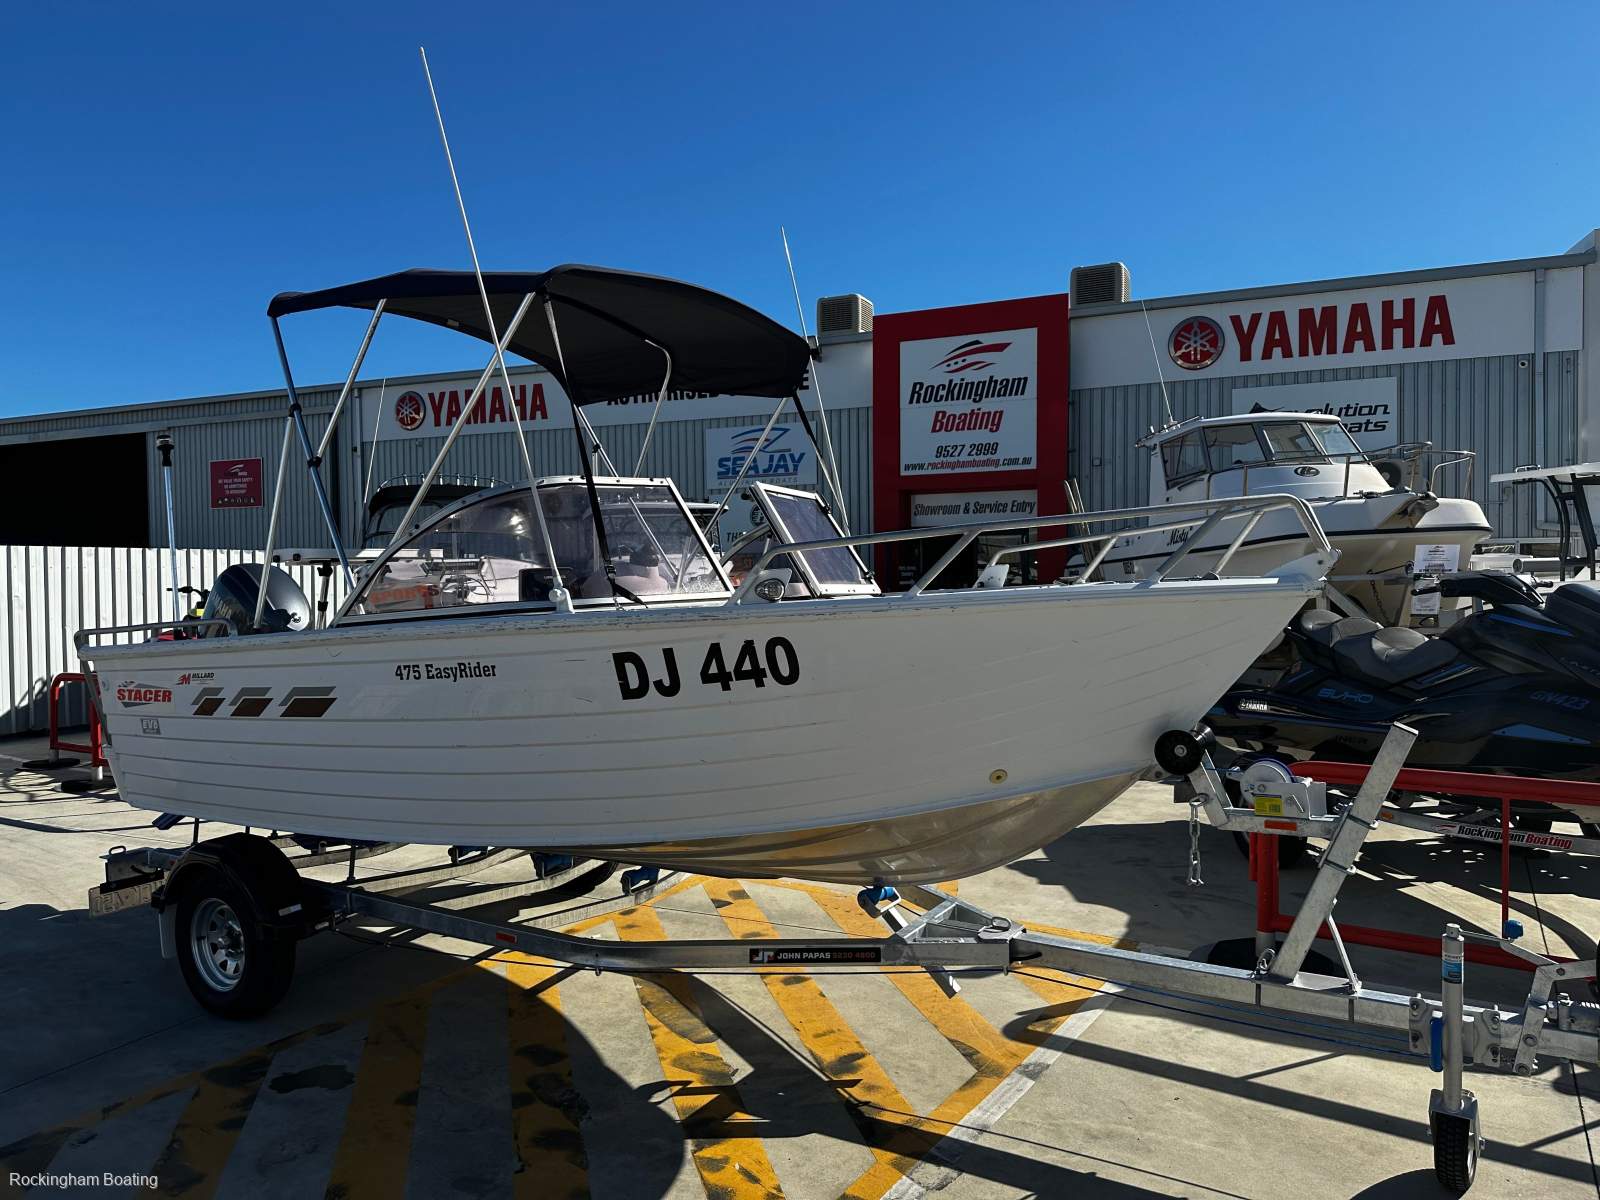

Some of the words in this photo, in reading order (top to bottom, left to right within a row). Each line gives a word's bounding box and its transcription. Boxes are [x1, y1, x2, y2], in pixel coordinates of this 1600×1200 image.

[1229, 294, 1456, 362] YAMAHA
[908, 375, 1028, 405] Rockingham
[427, 383, 548, 427] YAMAHA
[931, 407, 1004, 433] Boating
[935, 444, 966, 459] 9527
[967, 441, 999, 457] 2999
[904, 456, 1033, 471] www.rockinghamboating.com.au
[913, 503, 961, 517] Showroom
[962, 501, 971, 515] &
[972, 500, 1008, 514] Service
[1010, 499, 1036, 514] Entry
[395, 664, 422, 680] 475
[425, 661, 496, 682] EasyRider
[612, 647, 681, 700] DJ
[700, 636, 800, 691] 440
[117, 688, 172, 702] STACER
[1457, 825, 1525, 843] Rockingam
[777, 952, 800, 960] JOHN
